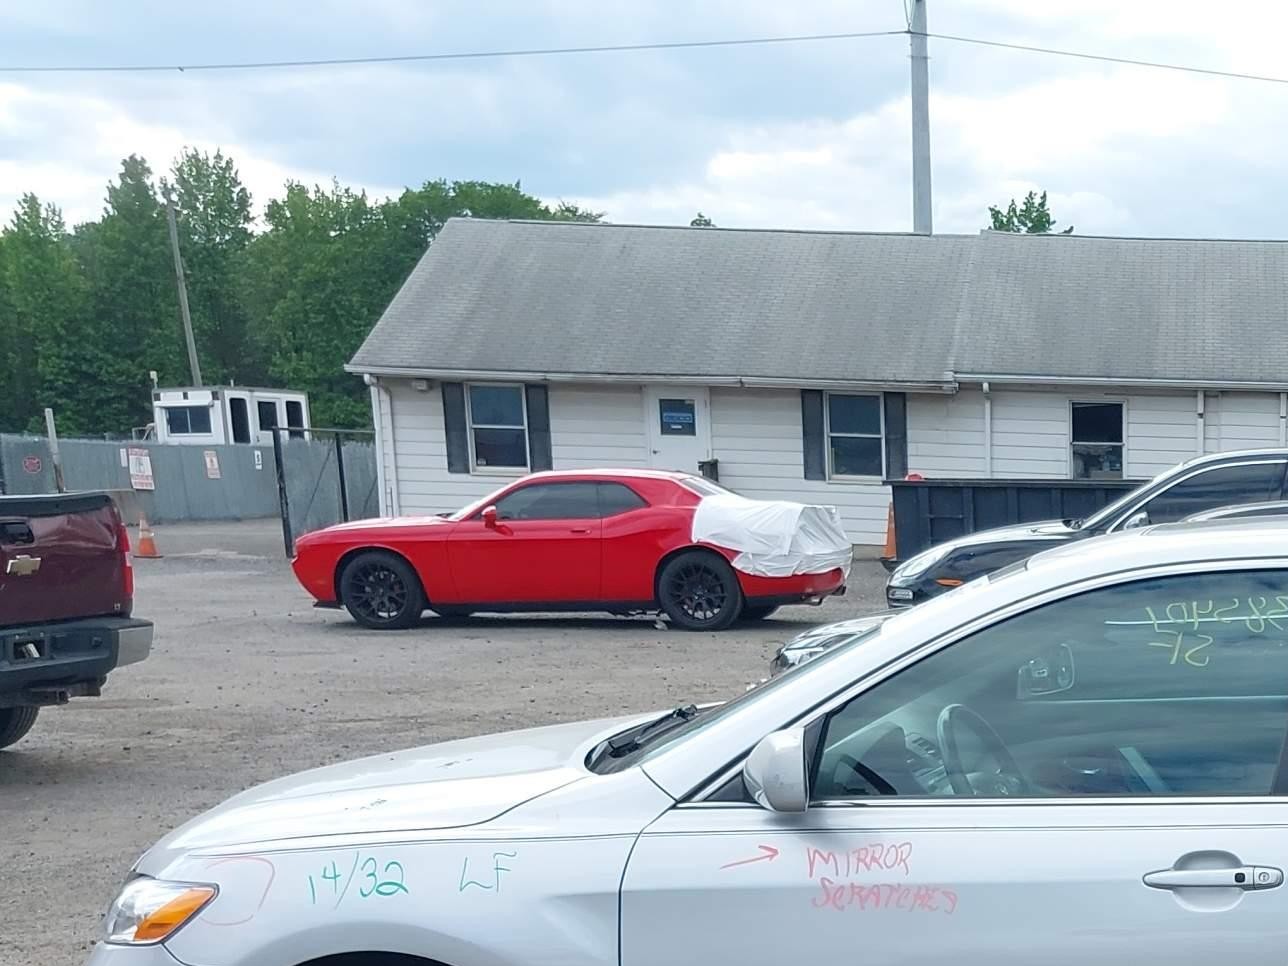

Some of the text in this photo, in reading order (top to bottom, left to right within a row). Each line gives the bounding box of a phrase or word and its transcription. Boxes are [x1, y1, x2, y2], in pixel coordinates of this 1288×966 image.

[308, 850, 518, 911] 14/32 LF
[806, 841, 913, 878] MIRROR
